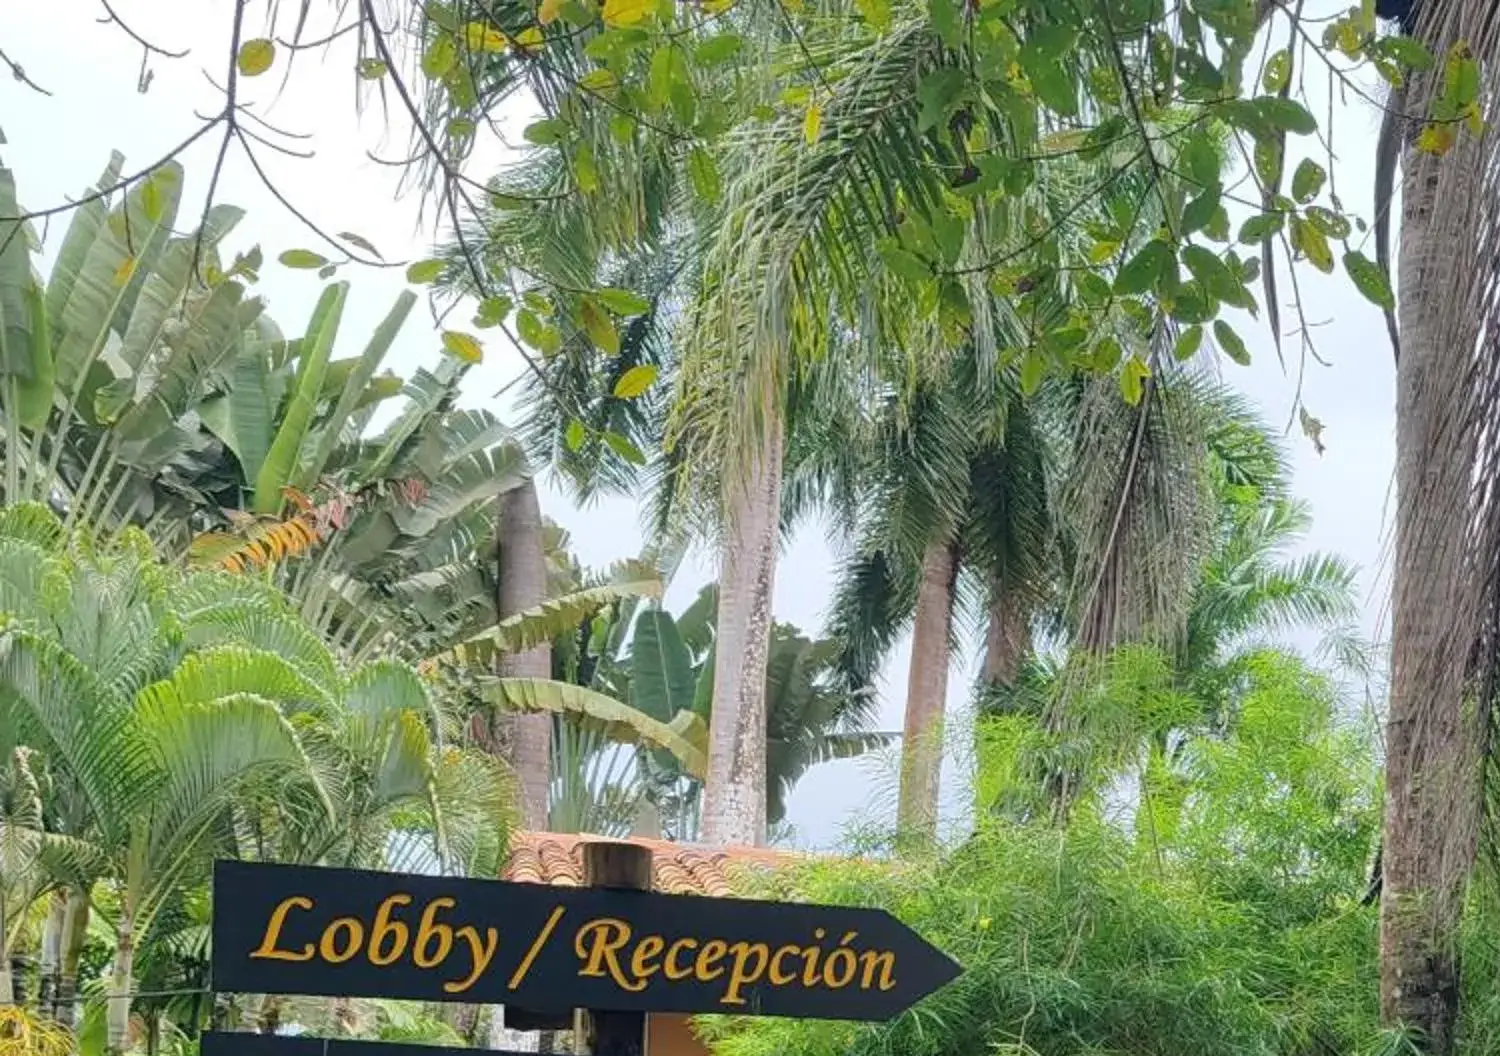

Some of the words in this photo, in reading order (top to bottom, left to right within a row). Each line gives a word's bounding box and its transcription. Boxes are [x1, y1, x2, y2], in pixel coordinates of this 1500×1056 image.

[250, 894, 498, 993] Lobby
[507, 906, 565, 990] /
[574, 918, 897, 1004] Recepción
